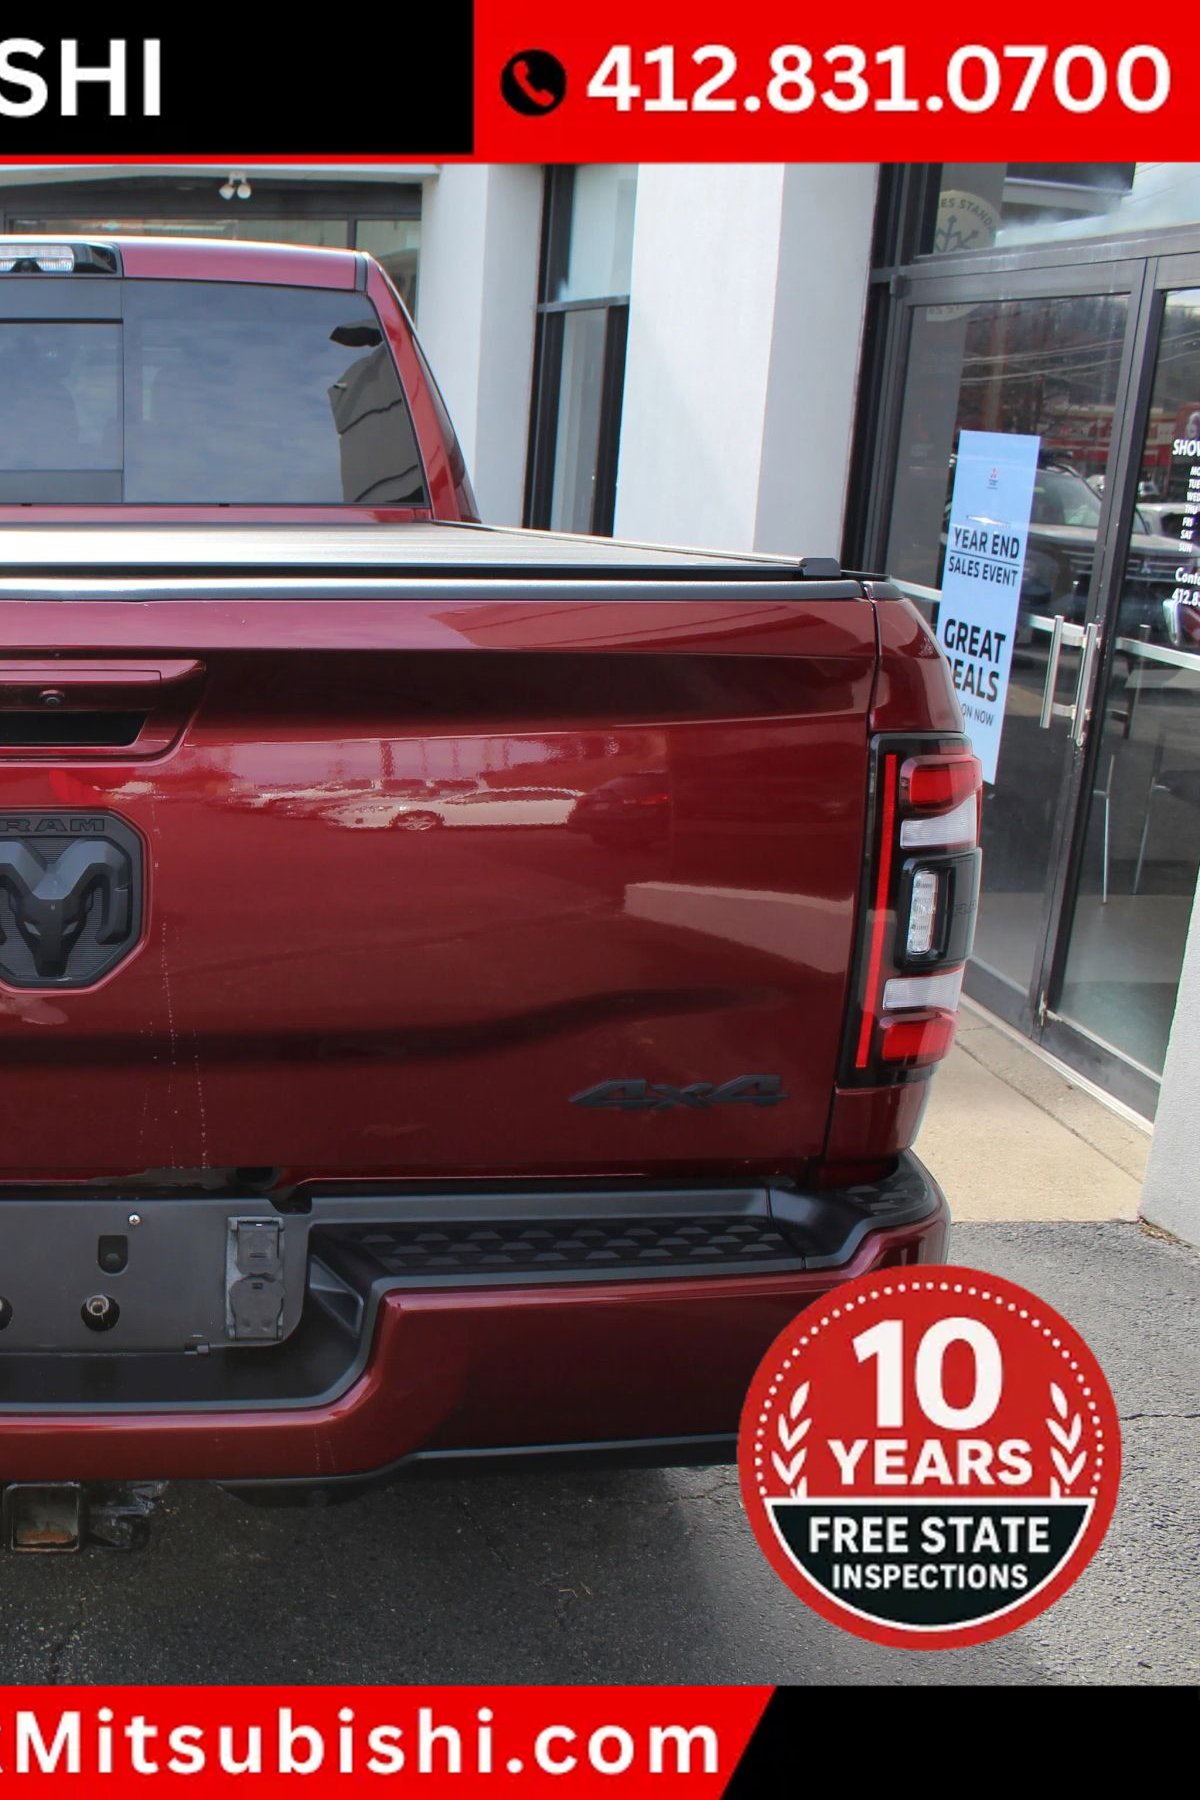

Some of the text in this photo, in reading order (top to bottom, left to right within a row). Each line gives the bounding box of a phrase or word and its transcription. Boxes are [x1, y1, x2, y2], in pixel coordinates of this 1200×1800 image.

[1172, 438, 1200, 457] SHO
[1182, 516, 1194, 528] FRI
[954, 526, 1020, 559] YEAR END
[1180, 529, 1194, 540] SAT
[1178, 541, 1193, 553] SUN
[948, 555, 1018, 587] SALES EVENT
[944, 618, 1006, 664] GREAT
[974, 707, 995, 727] NOW
